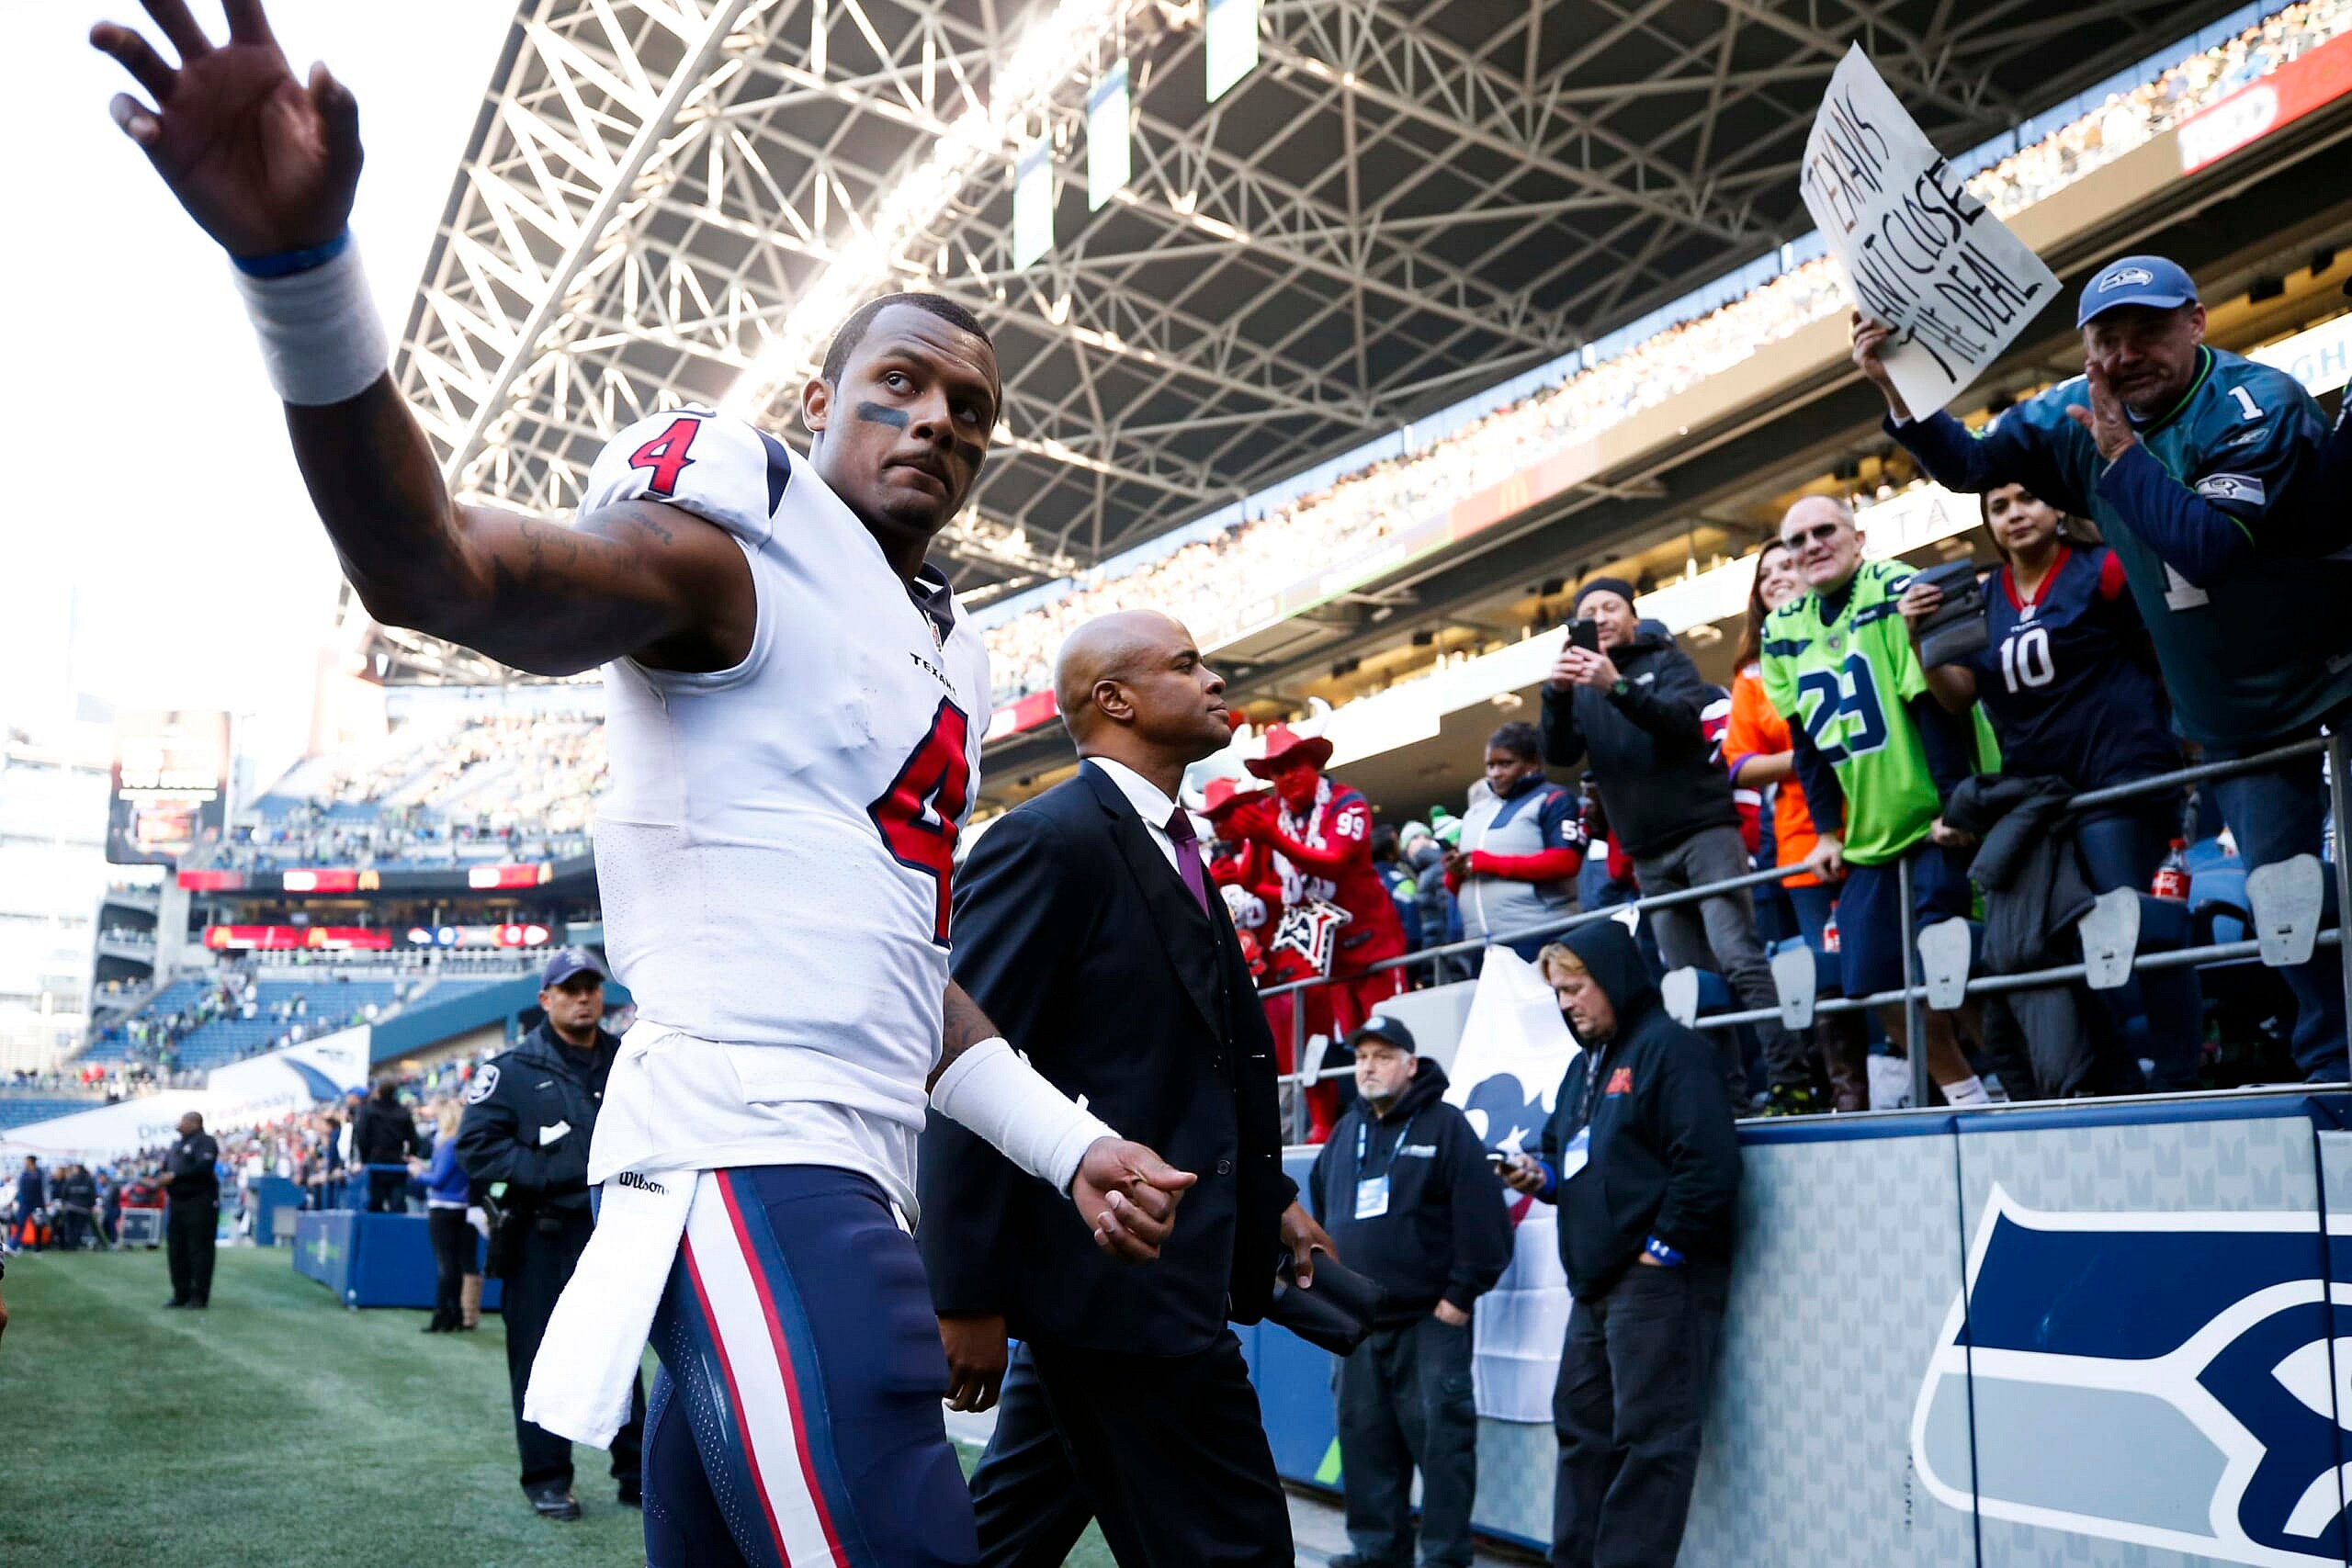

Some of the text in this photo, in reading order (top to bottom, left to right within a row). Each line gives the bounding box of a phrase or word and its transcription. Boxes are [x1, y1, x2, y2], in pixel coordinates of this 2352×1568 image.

[1807, 84, 1890, 236] TEXANS
[1850, 156, 1986, 335] ANT CLOSE
[1898, 242, 2043, 384] THE DEAL
[2227, 385, 2265, 421] 1
[627, 417, 702, 497] 4
[1796, 649, 1890, 768] 29
[1999, 627, 2055, 694] 10
[866, 694, 968, 947] 4
[1335, 811, 1366, 841] 99
[618, 1170, 666, 1196] Wilson
